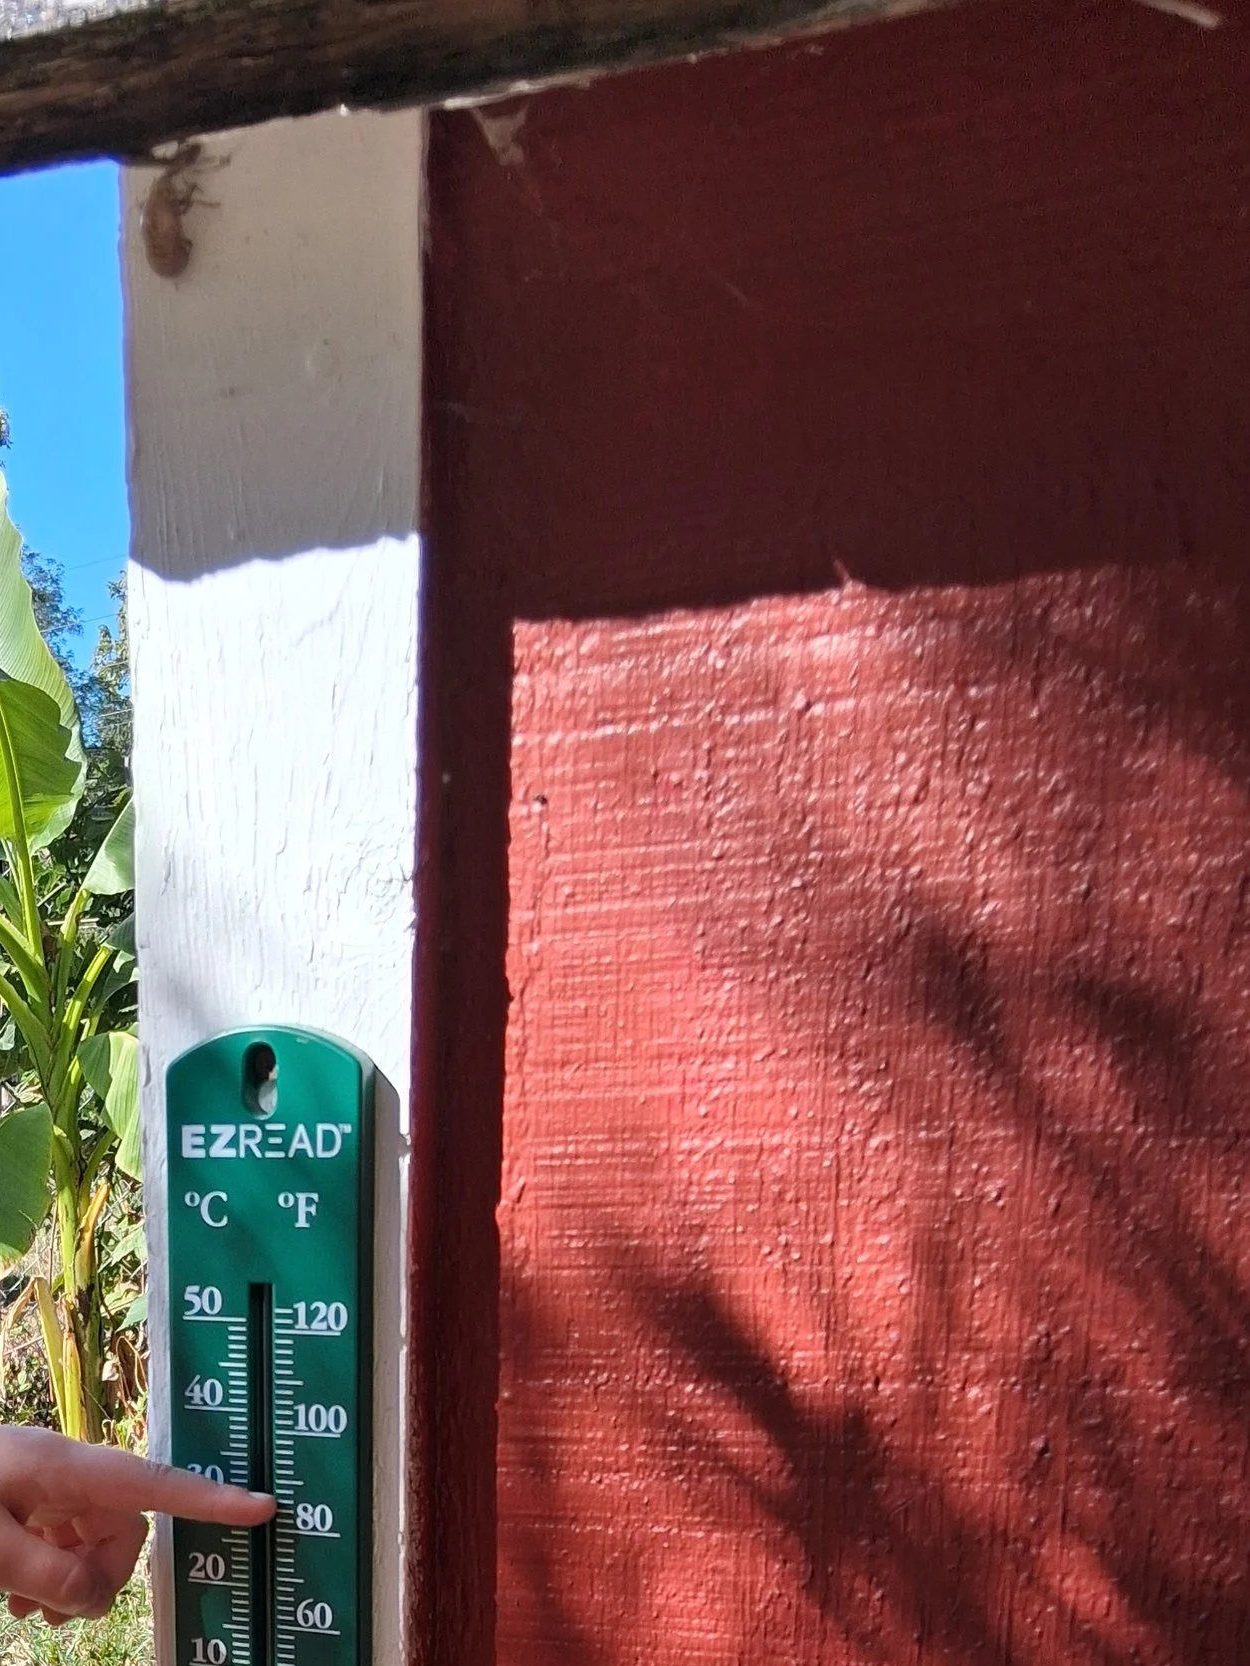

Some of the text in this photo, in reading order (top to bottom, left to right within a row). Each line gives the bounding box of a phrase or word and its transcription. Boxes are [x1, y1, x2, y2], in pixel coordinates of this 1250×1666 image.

[184, 1191, 229, 1228] °C
[278, 1191, 319, 1228] °F
[184, 1285, 223, 1316] 50
[292, 1301, 348, 1332] 120
[184, 1374, 223, 1406] 40
[293, 1404, 348, 1434] 100
[296, 1503, 333, 1532] 80
[188, 1551, 225, 1580] 20
[296, 1598, 333, 1629] 60
[191, 1637, 227, 1665] 10
